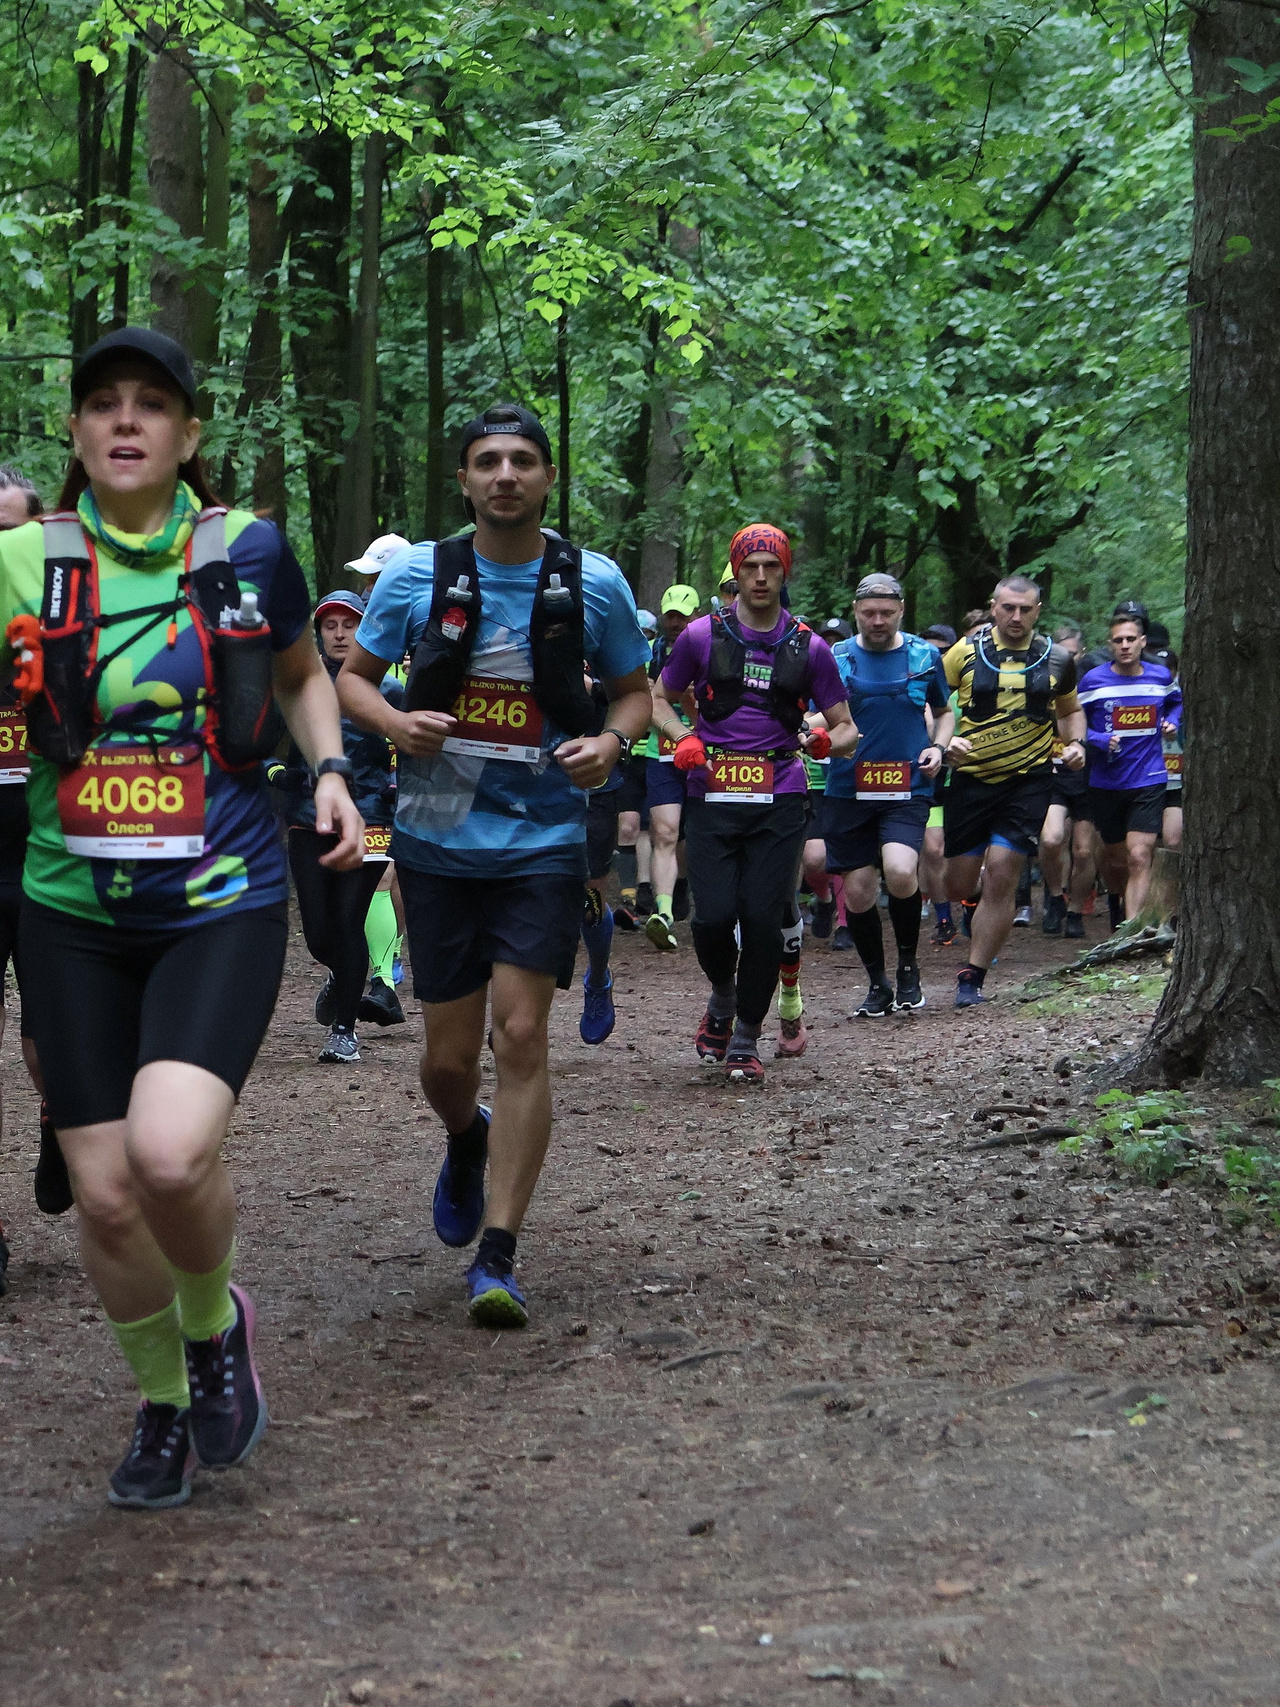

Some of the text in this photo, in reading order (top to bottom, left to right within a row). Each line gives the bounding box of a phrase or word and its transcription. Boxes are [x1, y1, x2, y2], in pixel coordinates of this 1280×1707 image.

[497, 683, 516, 691] TRAIL
[452, 694, 527, 728] 4246
[1118, 711, 1151, 725] 4244
[715, 766, 764, 783] 4103
[863, 771, 903, 785] 4182
[77, 776, 185, 814] 4068
[106, 821, 154, 834] Олеся
[364, 834, 392, 847] 085
